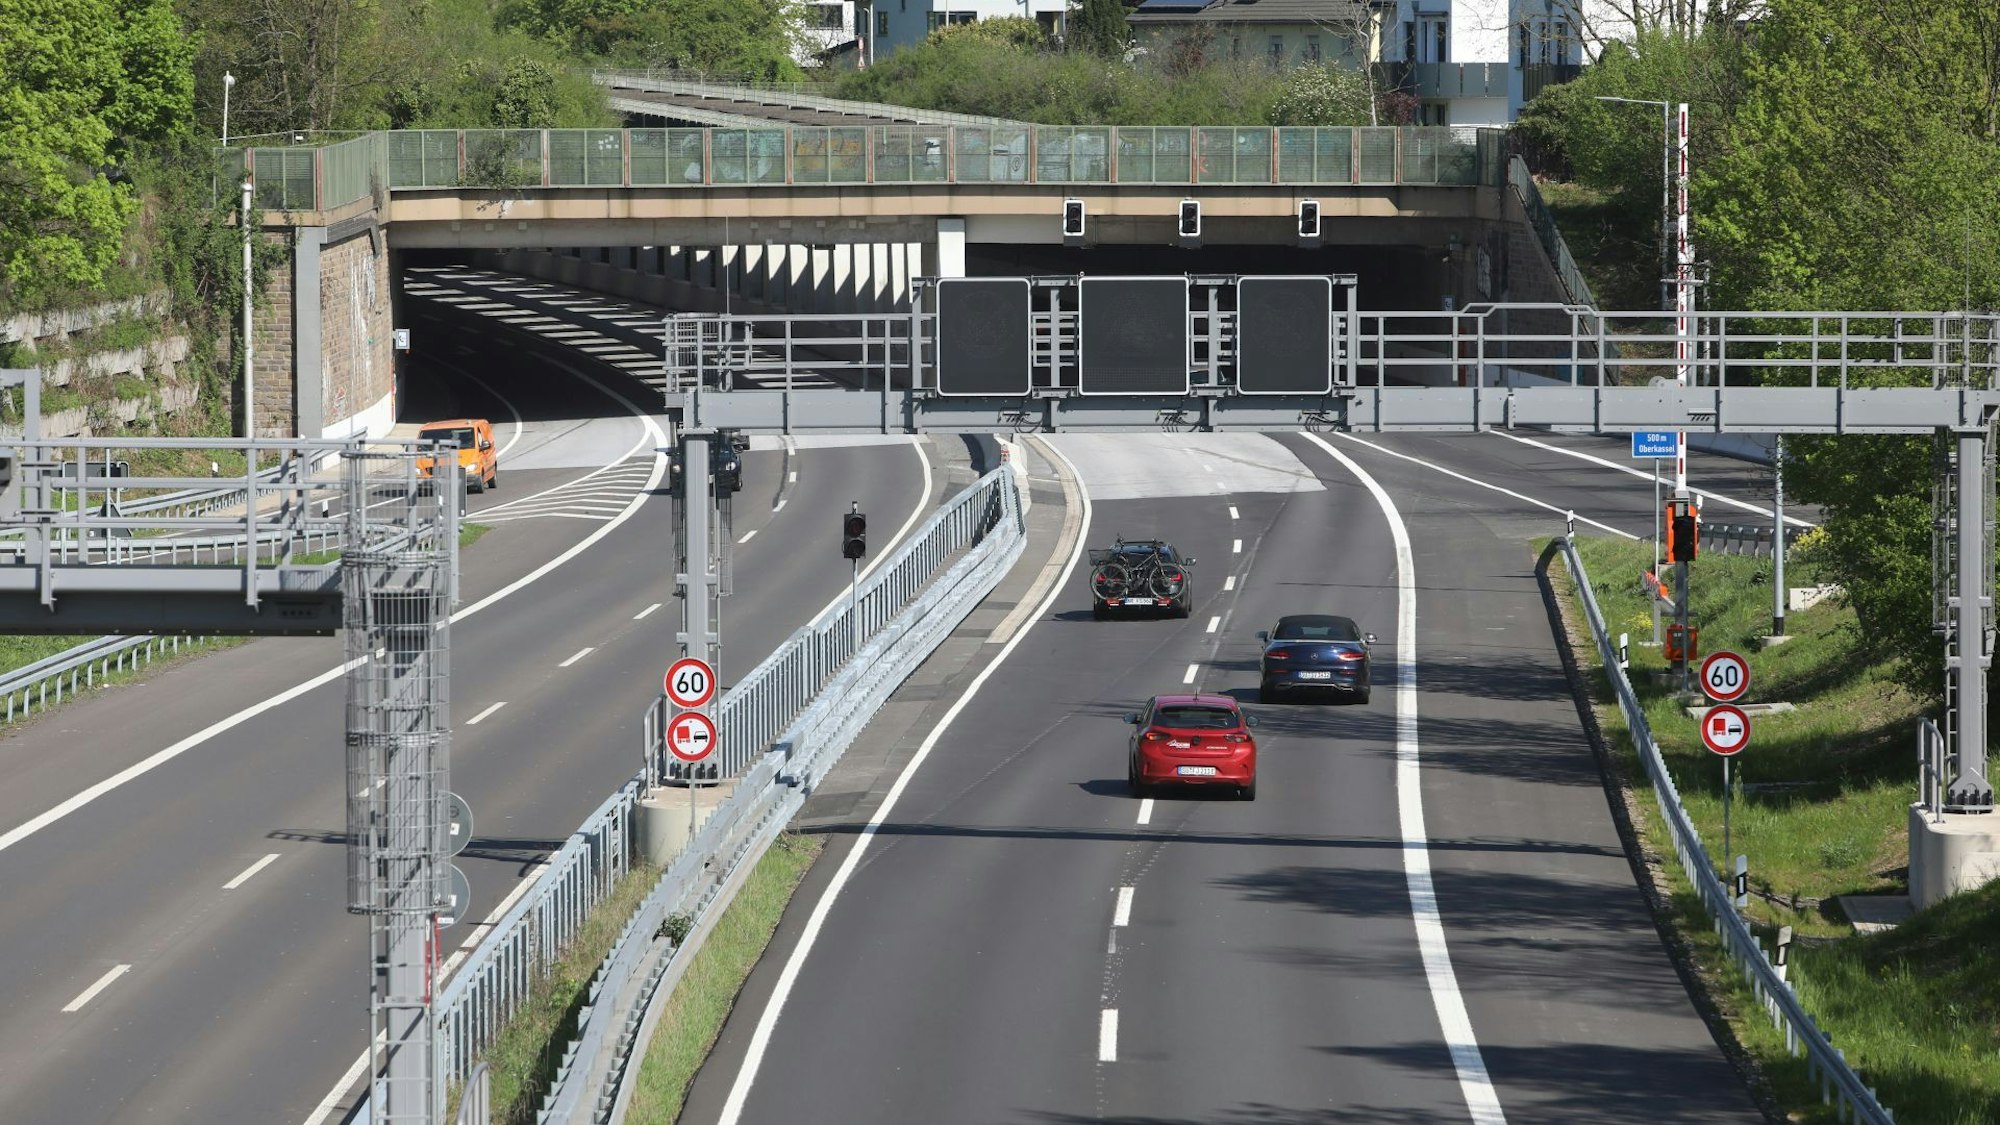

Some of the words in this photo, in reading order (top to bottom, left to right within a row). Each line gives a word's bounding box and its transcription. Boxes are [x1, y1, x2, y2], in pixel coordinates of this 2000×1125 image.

[1647, 433, 1660, 442] 500
[1638, 444, 1676, 453] Oberkassel
[676, 671, 704, 694] 60
[1711, 665, 1738, 687] 60
